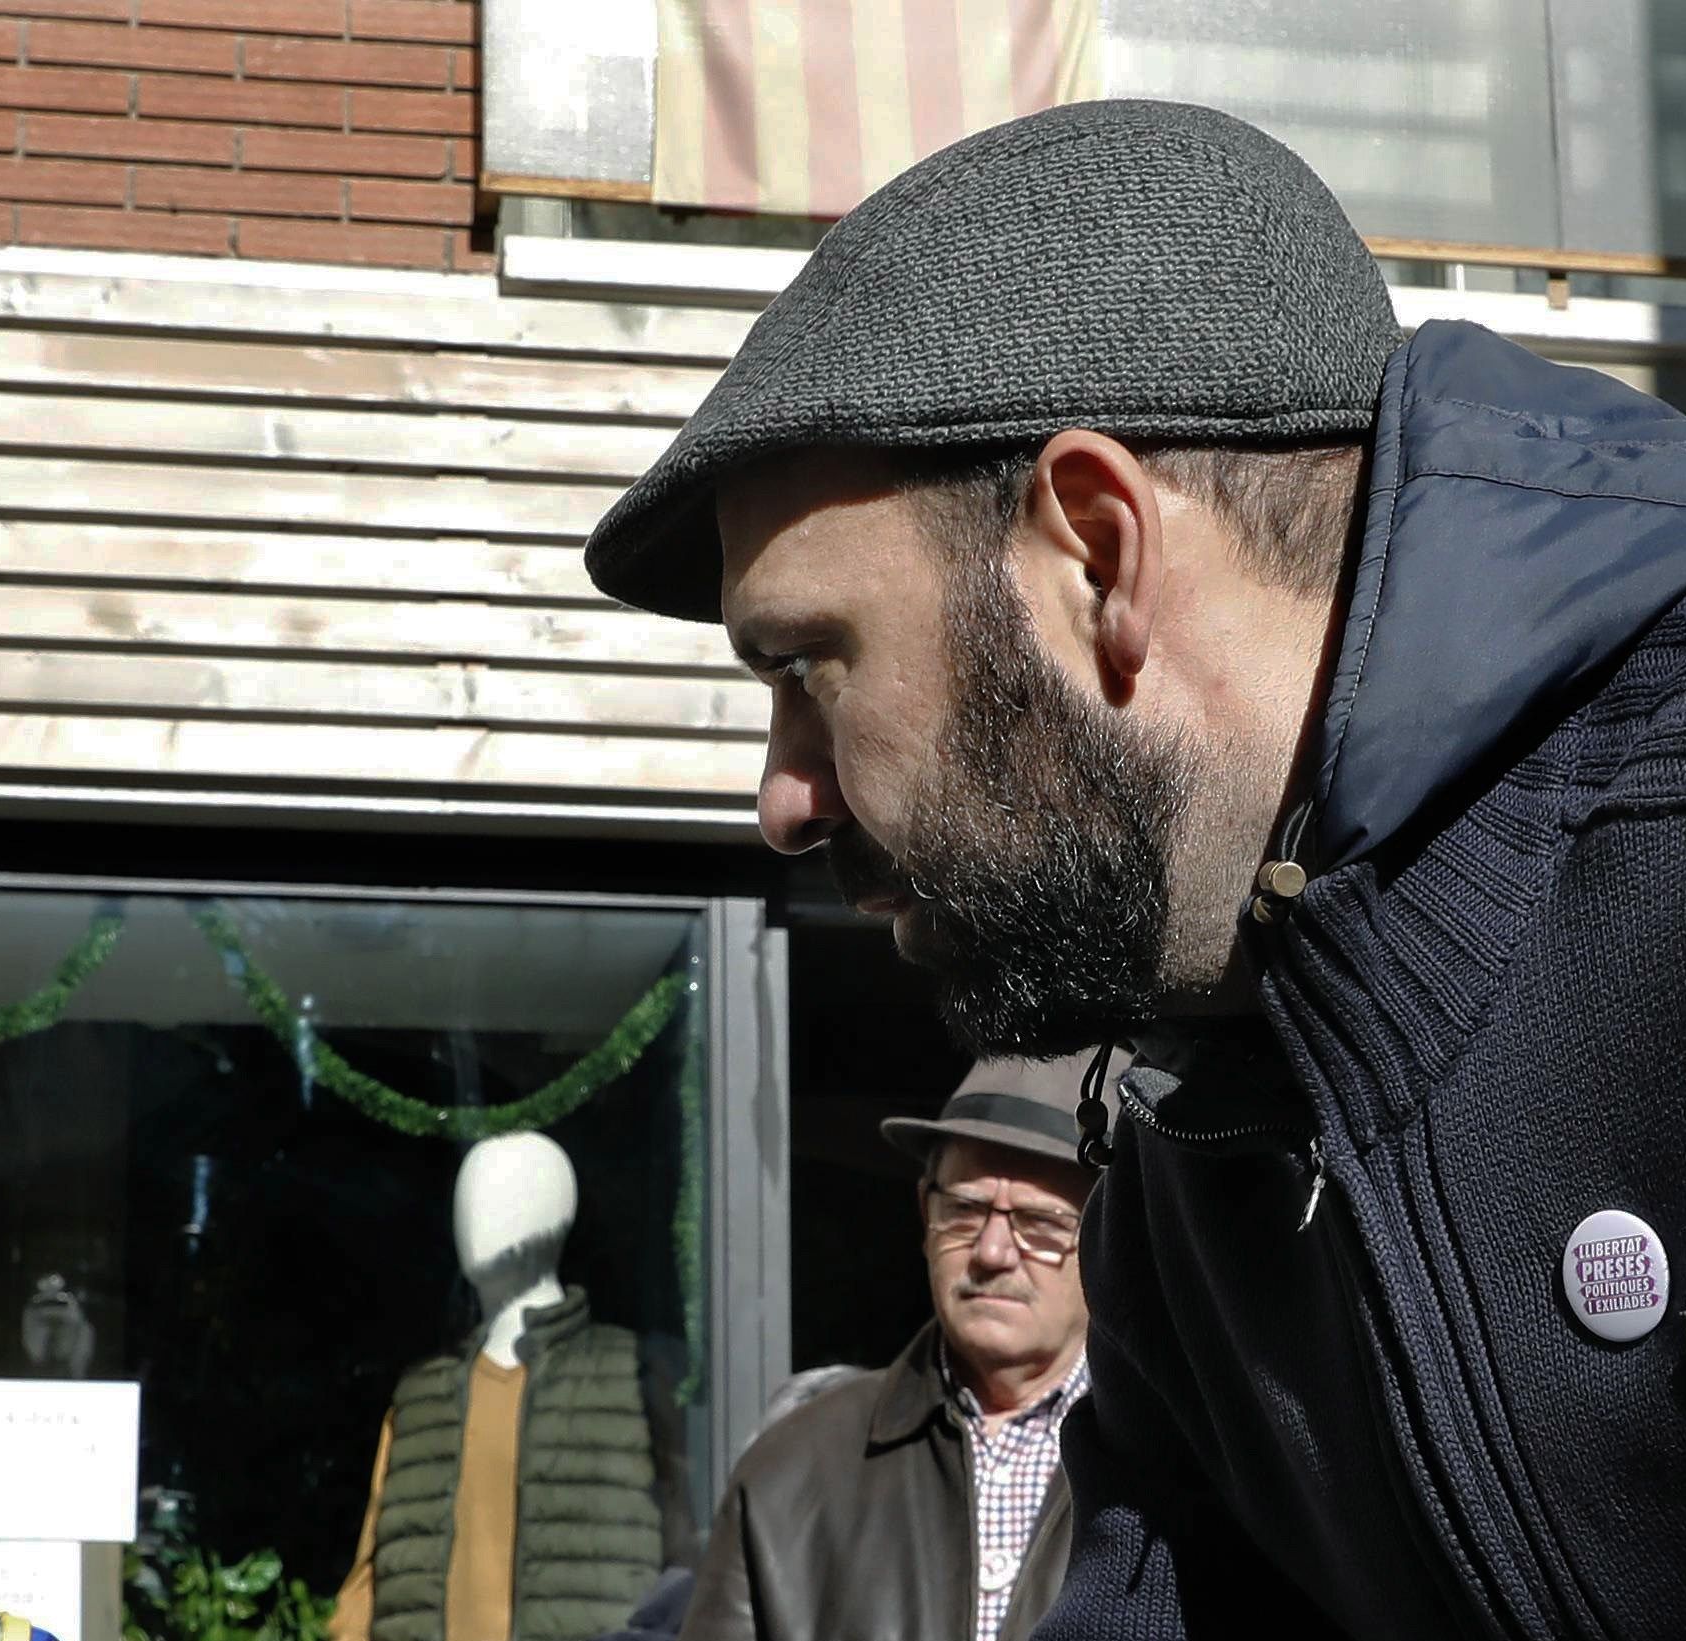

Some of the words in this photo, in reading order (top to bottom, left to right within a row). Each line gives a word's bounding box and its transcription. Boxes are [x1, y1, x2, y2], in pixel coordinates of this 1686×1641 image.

[1579, 1237, 1642, 1258] LLIBERTAT
[1582, 1256, 1646, 1281] PRESES
[1585, 1280, 1649, 1298] POLITIQUES
[1597, 1295, 1652, 1312] EXILIADES
